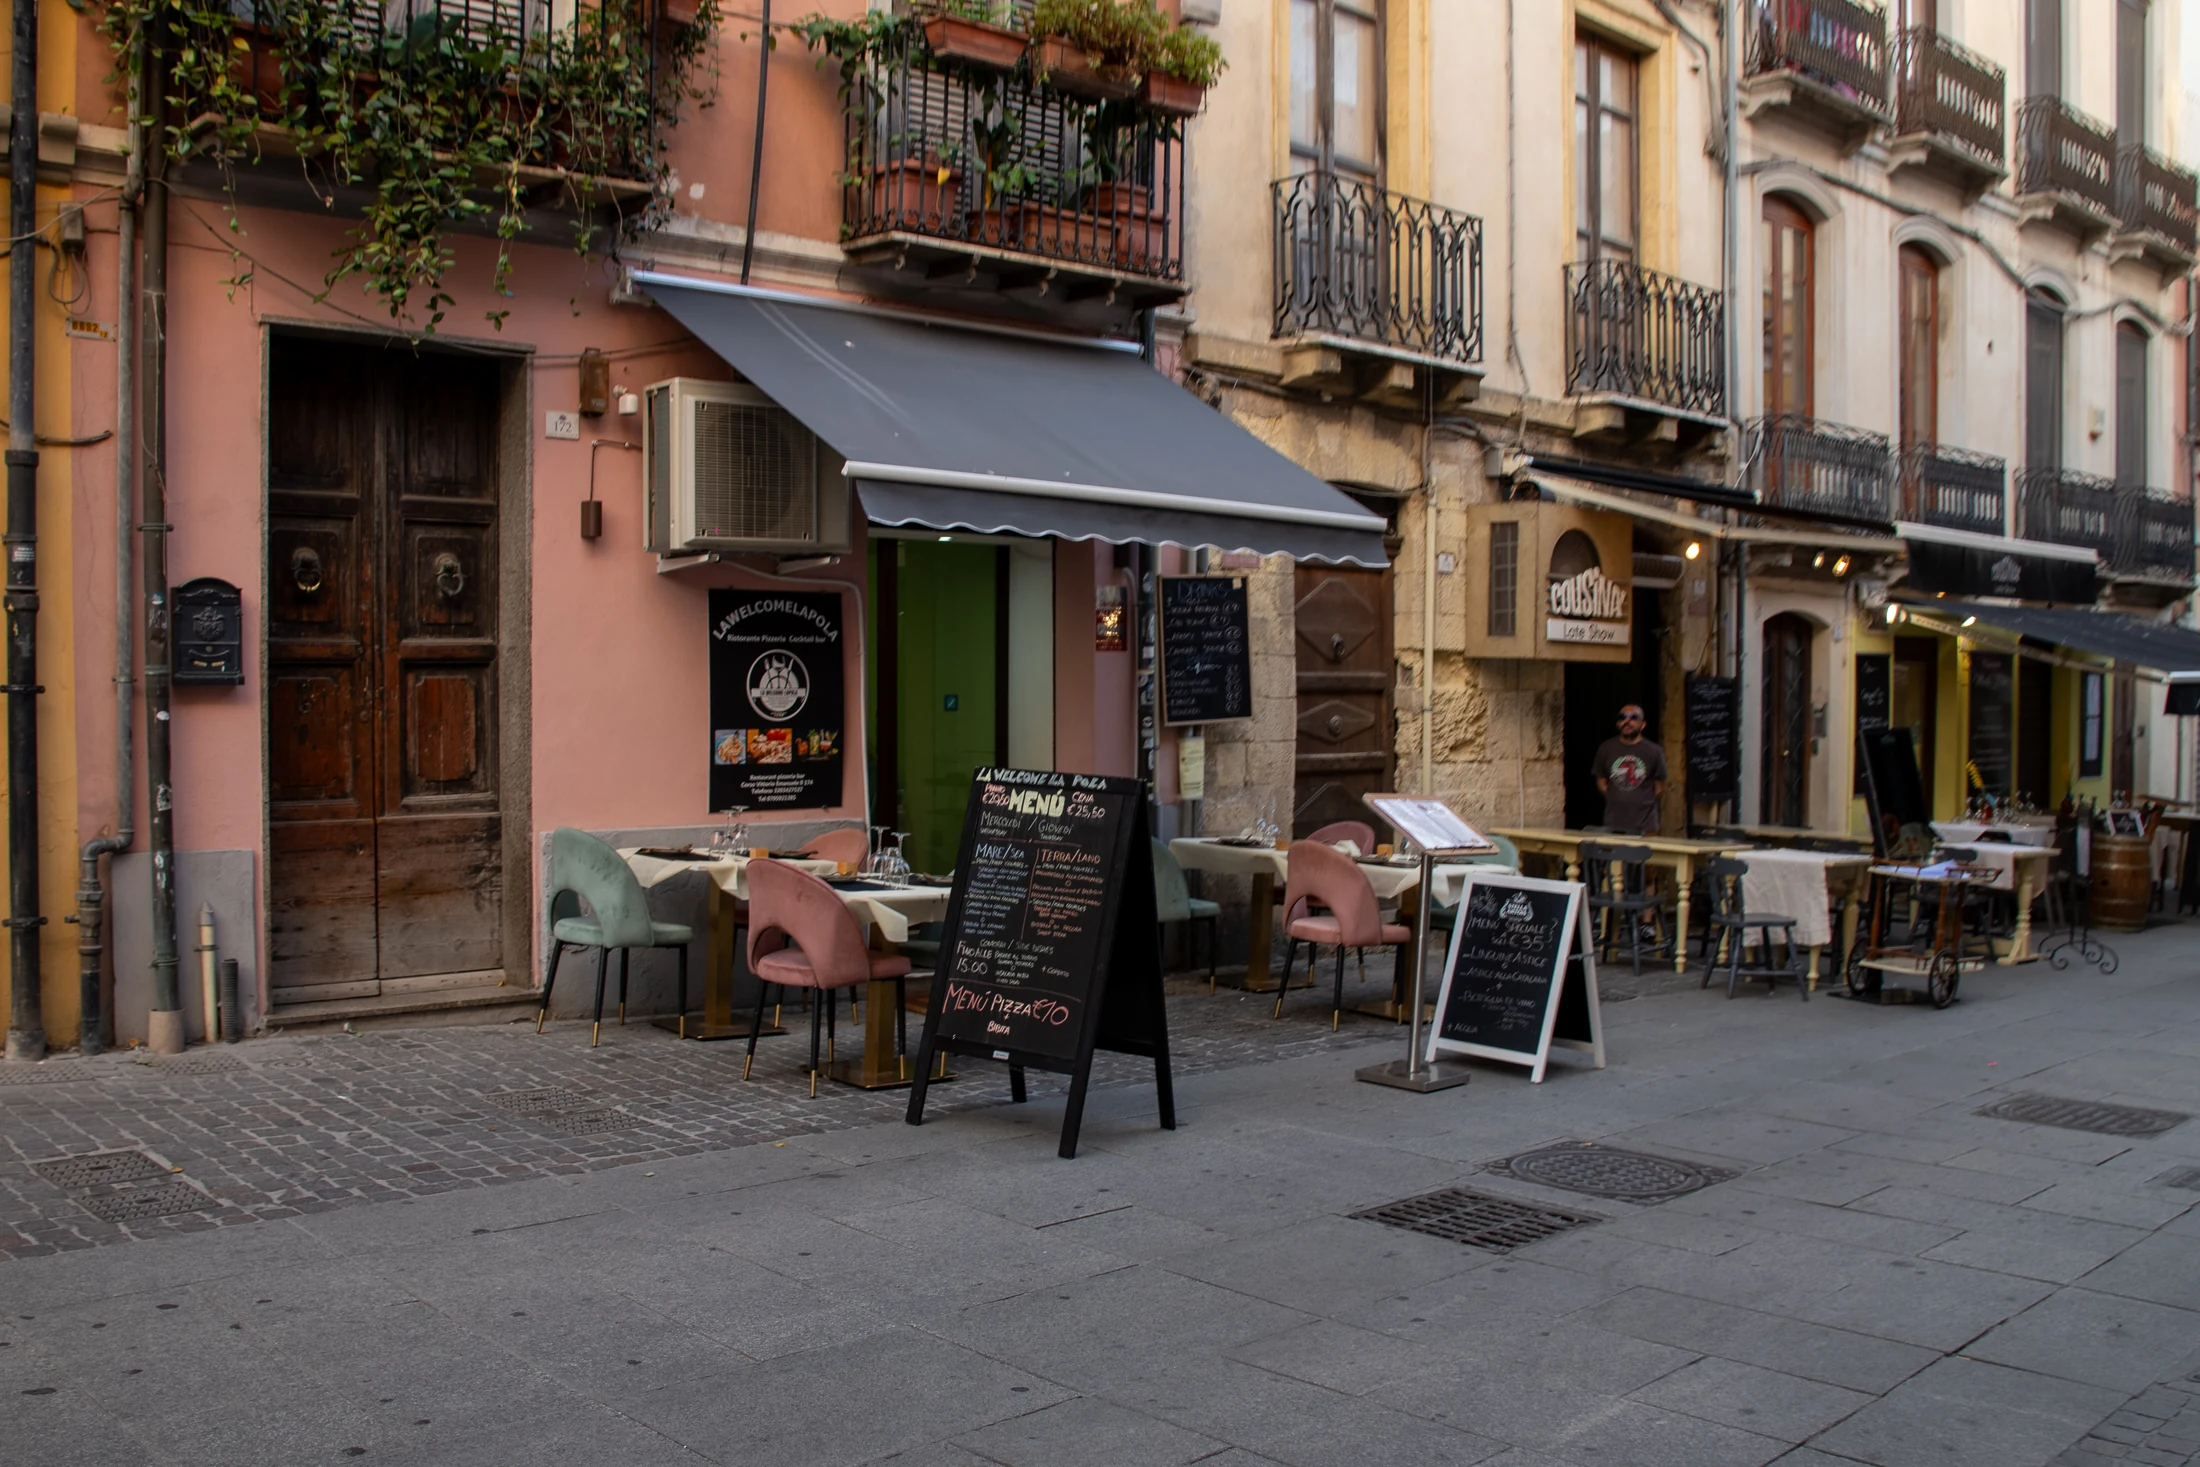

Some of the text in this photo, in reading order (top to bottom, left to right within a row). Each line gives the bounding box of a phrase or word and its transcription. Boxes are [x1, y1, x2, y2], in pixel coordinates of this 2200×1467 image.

[554, 420, 572, 433] 172
[712, 599, 839, 643] LAWELCOMELAPOLA
[727, 634, 826, 643] Ristorante Pizzeria Cocktail bar
[1589, 623, 1615, 640] Show
[750, 774, 777, 782] Restaurant
[976, 767, 991, 782] LA
[994, 769, 1048, 785] WELCOME
[1072, 774, 1107, 790] POLA
[1008, 788, 1066, 818] MENÚ
[1072, 791, 1094, 804] CENA
[1512, 951, 1548, 968] ASTICE
[942, 982, 992, 1014] MENÚ
[990, 993, 1032, 1017] PIZZA
[987, 1020, 1011, 1036] BIBITA
